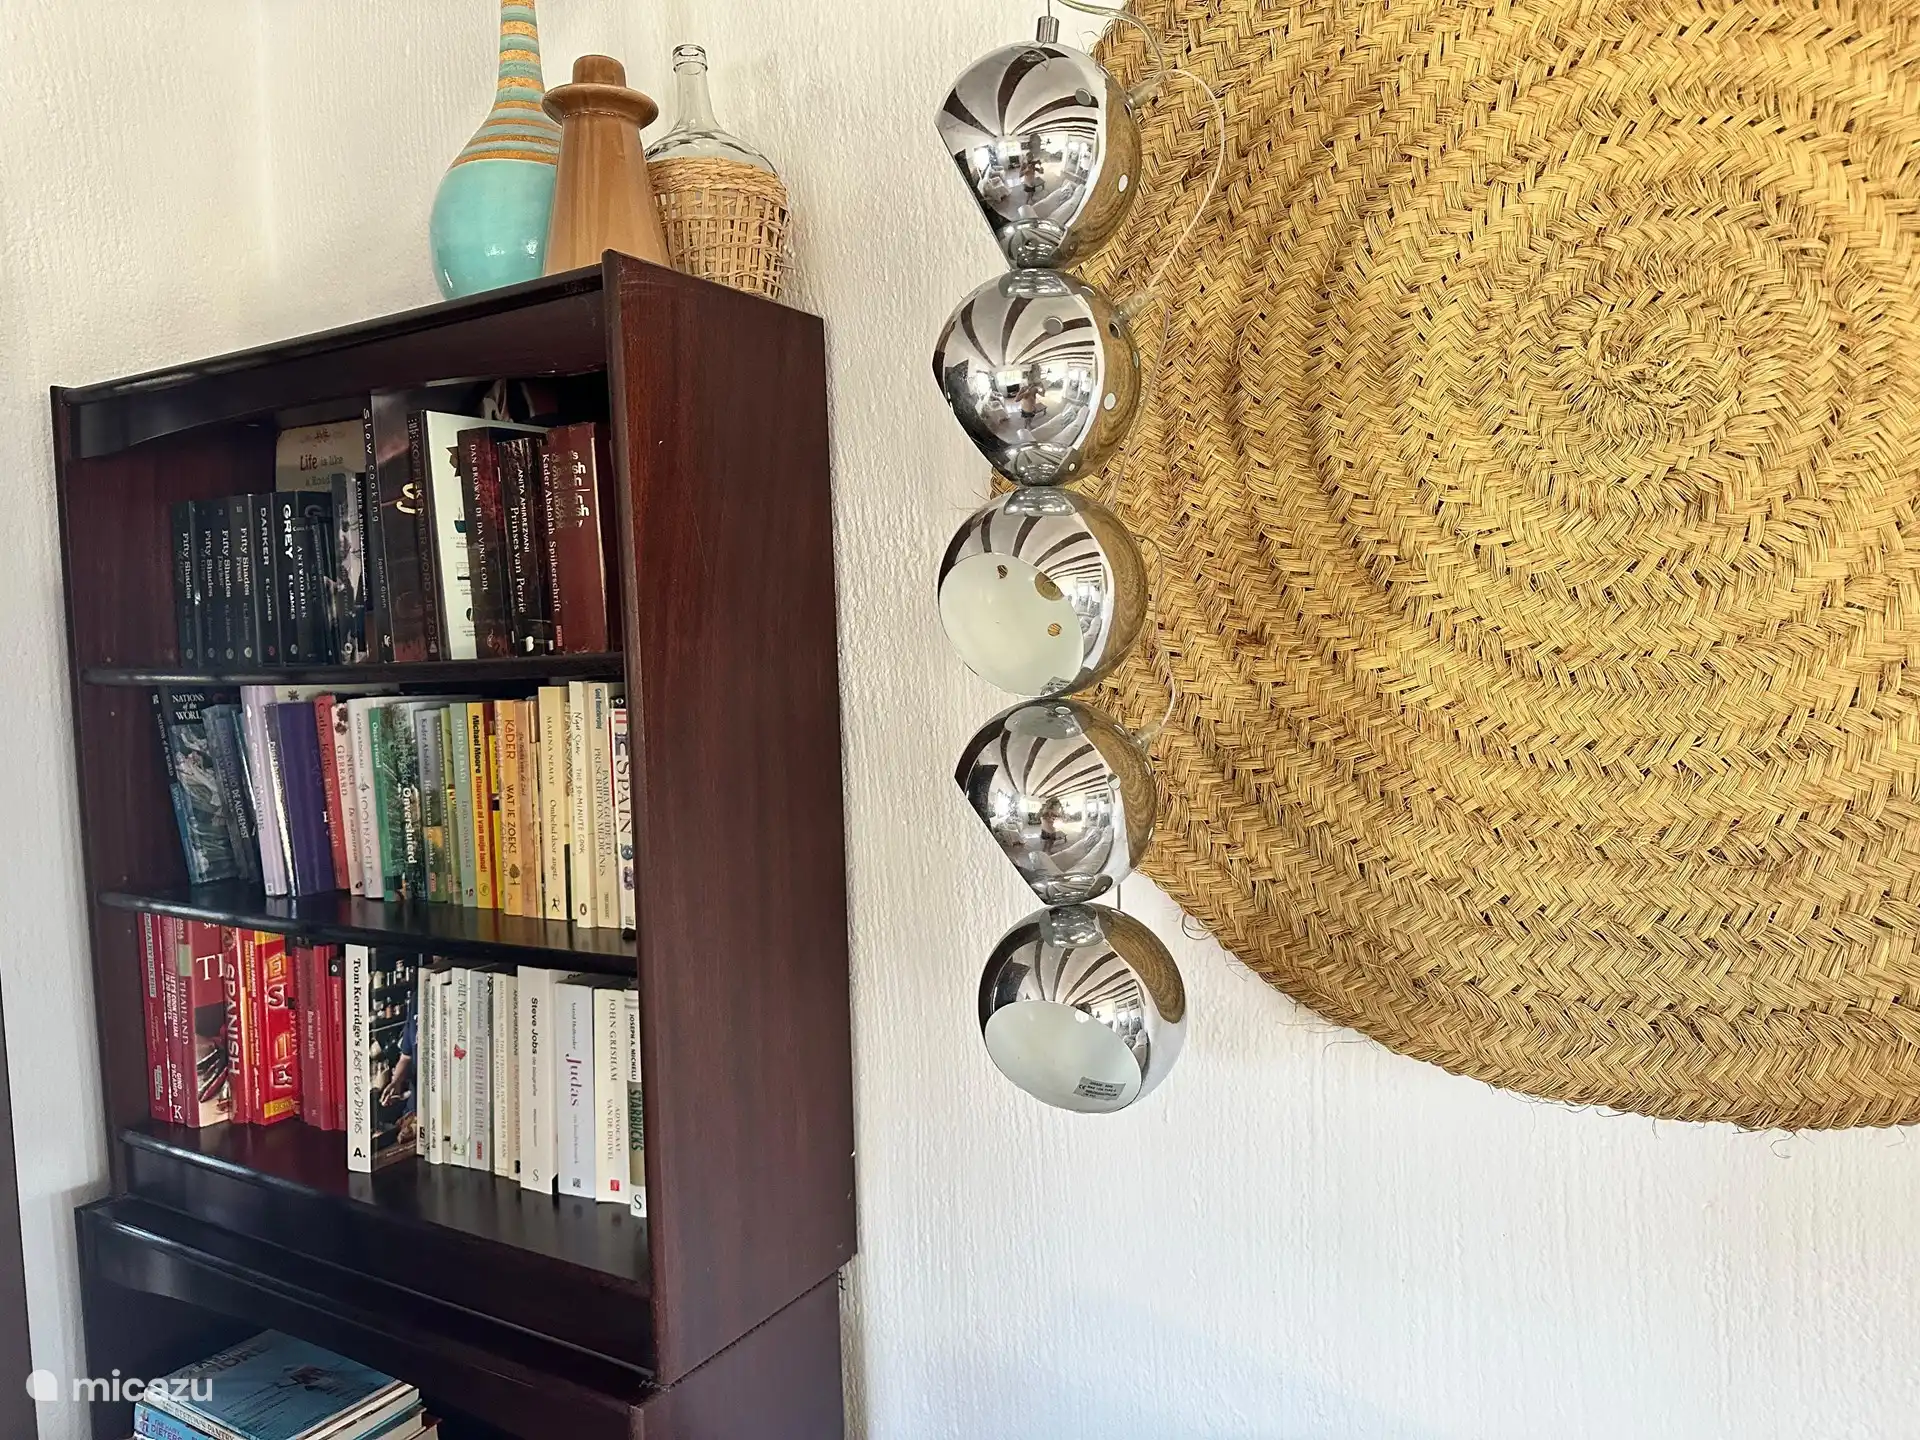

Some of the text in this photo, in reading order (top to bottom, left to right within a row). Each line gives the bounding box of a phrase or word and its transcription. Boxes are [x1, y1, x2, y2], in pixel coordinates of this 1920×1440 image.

[300, 455, 318, 471] Life
[469, 443, 479, 464] DAN
[541, 453, 552, 486] Kader
[368, 464, 381, 523] cooking
[471, 466, 481, 500] BROWN
[477, 521, 485, 534] DA
[517, 469, 531, 553] ANITA AMIRREZVANI
[544, 489, 556, 535] Abdolah
[181, 532, 190, 557] Fifty
[203, 530, 212, 556] Fifty
[259, 507, 270, 566] DARKER
[282, 503, 294, 559] GREY
[221, 529, 232, 598] Fifty Shades
[239, 527, 251, 596] Fifty Shades
[478, 537, 487, 564] VINCI
[510, 506, 527, 613] Prinses van Perzië
[183, 560, 193, 599] Shades
[206, 559, 215, 598] Shades
[296, 545, 307, 618] ANTWOORDEN
[419, 548, 432, 593] WORD
[548, 541, 562, 613] Spijkerschrift
[425, 596, 434, 612] JE
[171, 692, 206, 703] NATIONS
[175, 710, 202, 721] WORL
[316, 703, 332, 772] Cathy Kelly
[371, 722, 382, 768] Onze vriend
[456, 719, 465, 752] SHIRIN
[471, 715, 481, 746] Michael
[546, 716, 554, 751] MARINA
[335, 745, 348, 796] GERRARD
[346, 755, 356, 788] NICCI
[474, 747, 482, 774] Moore
[547, 754, 555, 787] NEMAT
[475, 776, 484, 810] Klauwen
[504, 719, 517, 854] KADER WAT JE ZOEKT
[616, 760, 631, 835] SPAIN
[576, 785, 585, 831] 30-MINUTE
[593, 748, 606, 877] PRESCRIPTION MEDICINES
[602, 770, 613, 856] FAMILY GUIDE TO
[363, 827, 373, 870] NACHT
[550, 835, 559, 854] door
[578, 833, 586, 854] COOK
[170, 975, 178, 993] LET'S
[353, 958, 361, 984] Tom
[171, 1013, 179, 1038] ITALIAN
[179, 980, 190, 1045] THAILAND
[224, 963, 241, 1074] SPANISH
[351, 985, 363, 1046] Kerridge's
[457, 1000, 467, 1043] Mansell
[530, 997, 538, 1027] Steve
[531, 1029, 539, 1055] Jobs
[608, 998, 619, 1081] JOHN GRISHAM
[171, 1063, 179, 1097] D'ACAMPO
[176, 1072, 184, 1090] GINO
[565, 1053, 583, 1107] Judas
[630, 1048, 638, 1080] MICHELLI
[606, 1098, 616, 1161] VAN DE DUIVEL
[614, 1106, 622, 1152] ADVOCAAT
[628, 1088, 644, 1152] STARBUCKS
[353, 1147, 366, 1159] A.
[531, 1168, 540, 1182] S
[633, 1193, 643, 1211] S
